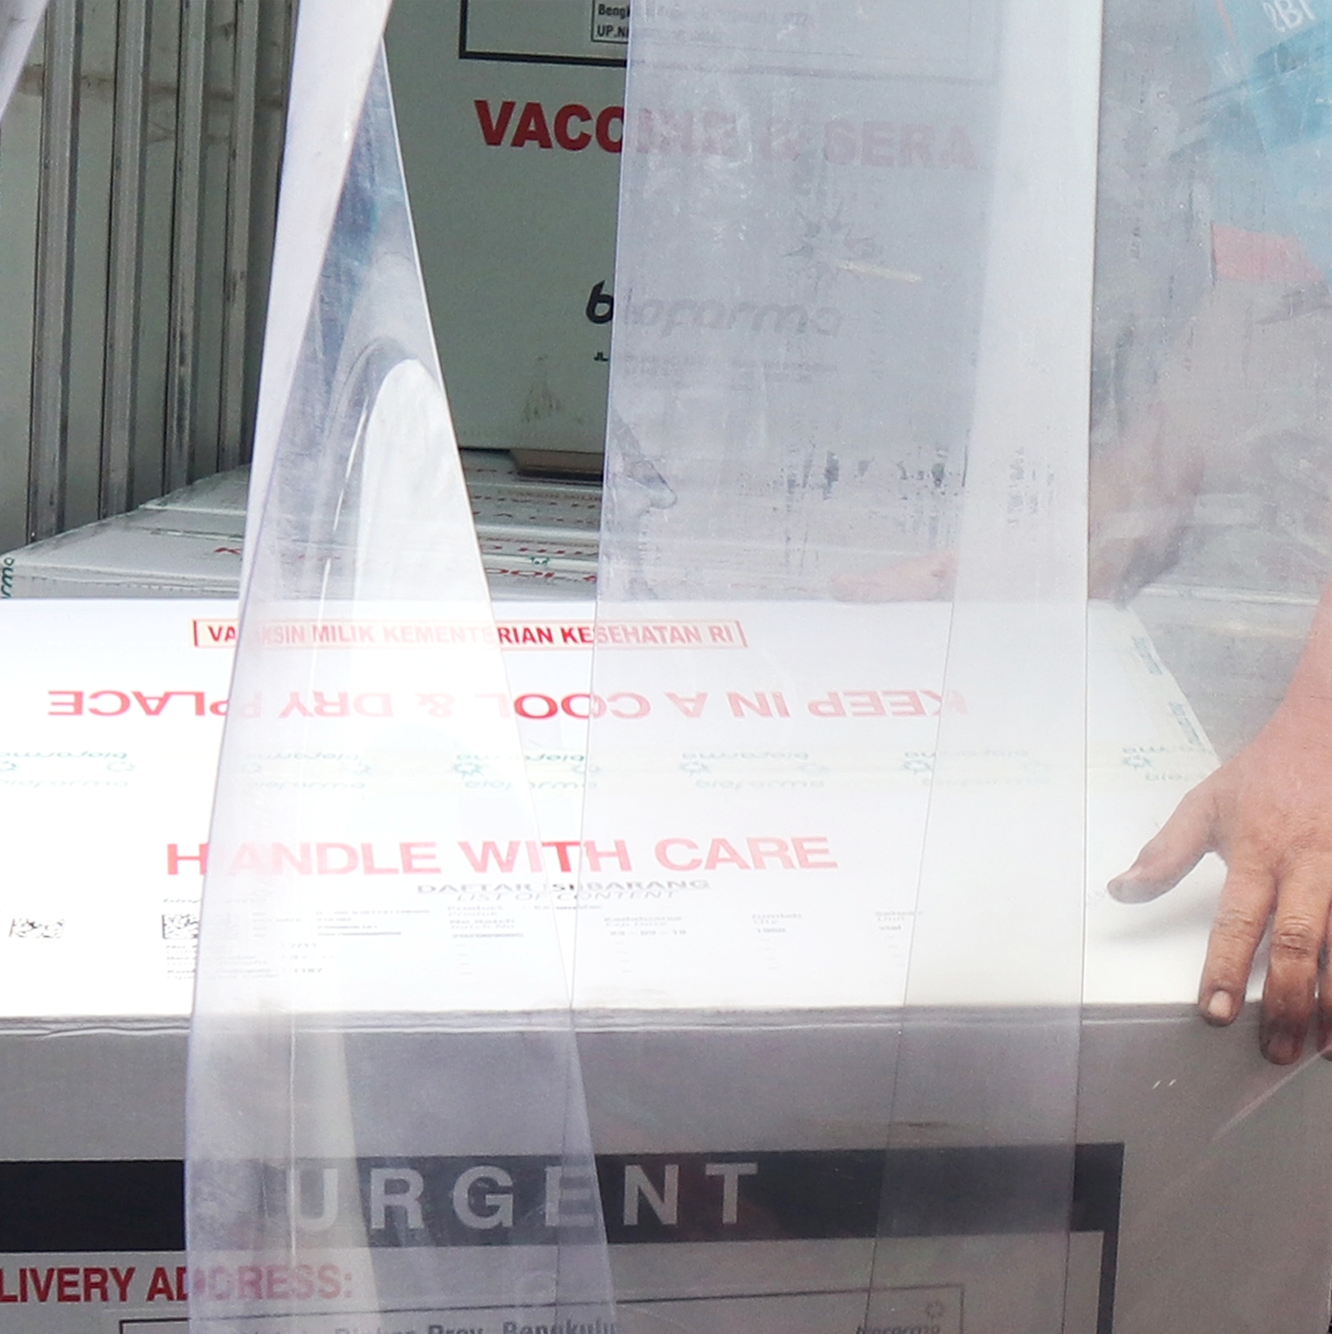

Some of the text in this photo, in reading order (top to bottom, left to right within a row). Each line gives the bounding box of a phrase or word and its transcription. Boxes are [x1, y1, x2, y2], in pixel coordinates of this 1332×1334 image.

[312, 624, 375, 645] MILIK
[383, 624, 552, 646] KEMENTERIAN
[557, 626, 699, 646] KESEHATAN
[705, 627, 737, 644] RI
[48, 689, 969, 720] KEEP IN A COOL & DRY PLACE
[166, 836, 839, 876] HANDLE WITH CARE
[291, 1161, 759, 1231] URGENT
[147, 1263, 355, 1302] ADDRESS:
